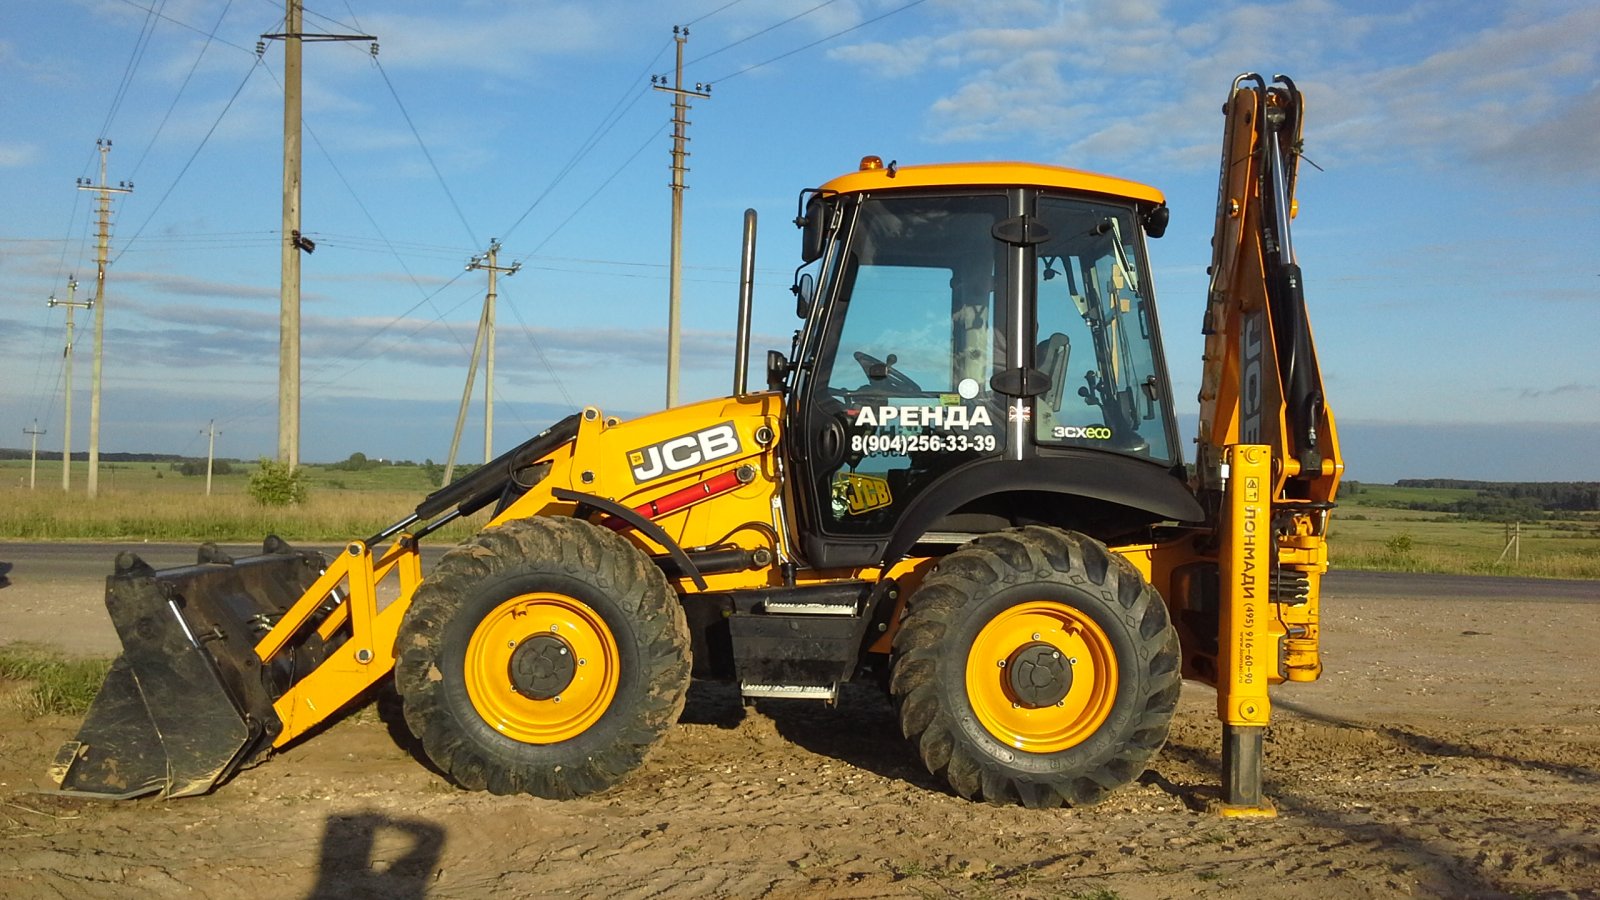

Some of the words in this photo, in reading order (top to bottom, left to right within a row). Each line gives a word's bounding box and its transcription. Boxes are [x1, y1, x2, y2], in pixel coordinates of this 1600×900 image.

[855, 406, 992, 430] АРЕНДА
[634, 425, 738, 480] JCB
[851, 435, 995, 455] 8(904)256-33-39
[848, 475, 889, 511] JCB
[1240, 507, 1256, 599] ЛОНМАДИ
[1243, 603, 1255, 629] (495)
[1244, 631, 1255, 685] 916-60-90
